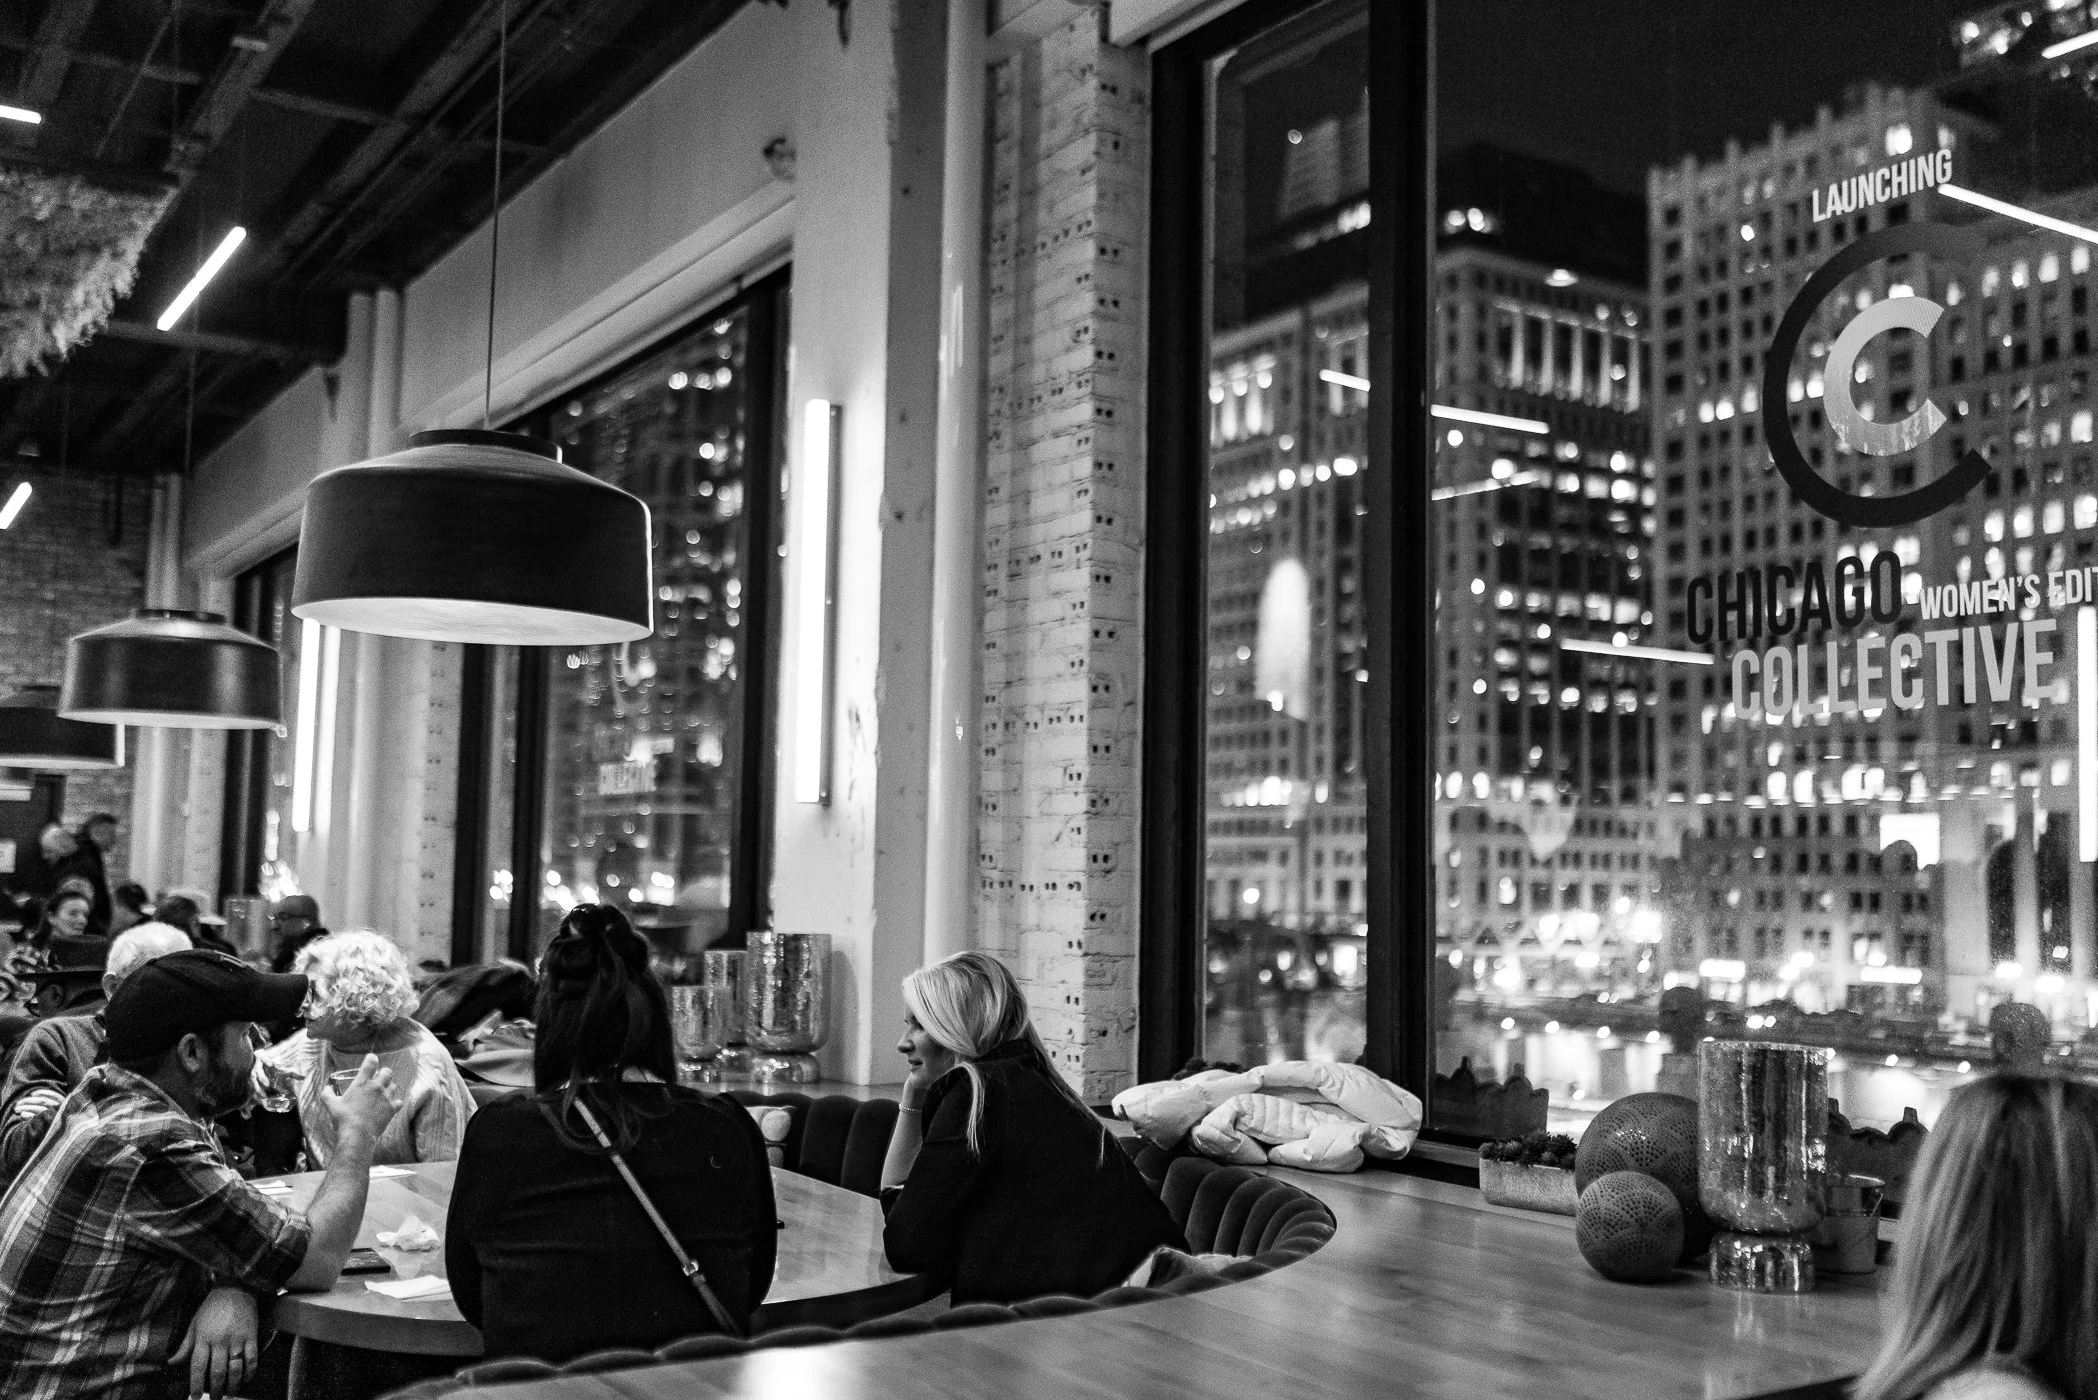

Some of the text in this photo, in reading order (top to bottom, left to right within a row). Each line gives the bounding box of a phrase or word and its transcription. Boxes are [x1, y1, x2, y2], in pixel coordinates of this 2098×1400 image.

[1812, 149, 1952, 223] LAUNCHING
[1686, 550, 1902, 644] CHICAGO
[1919, 574, 2041, 620] WOMEN'S
[1732, 618, 2058, 720] COLLECTIVE
